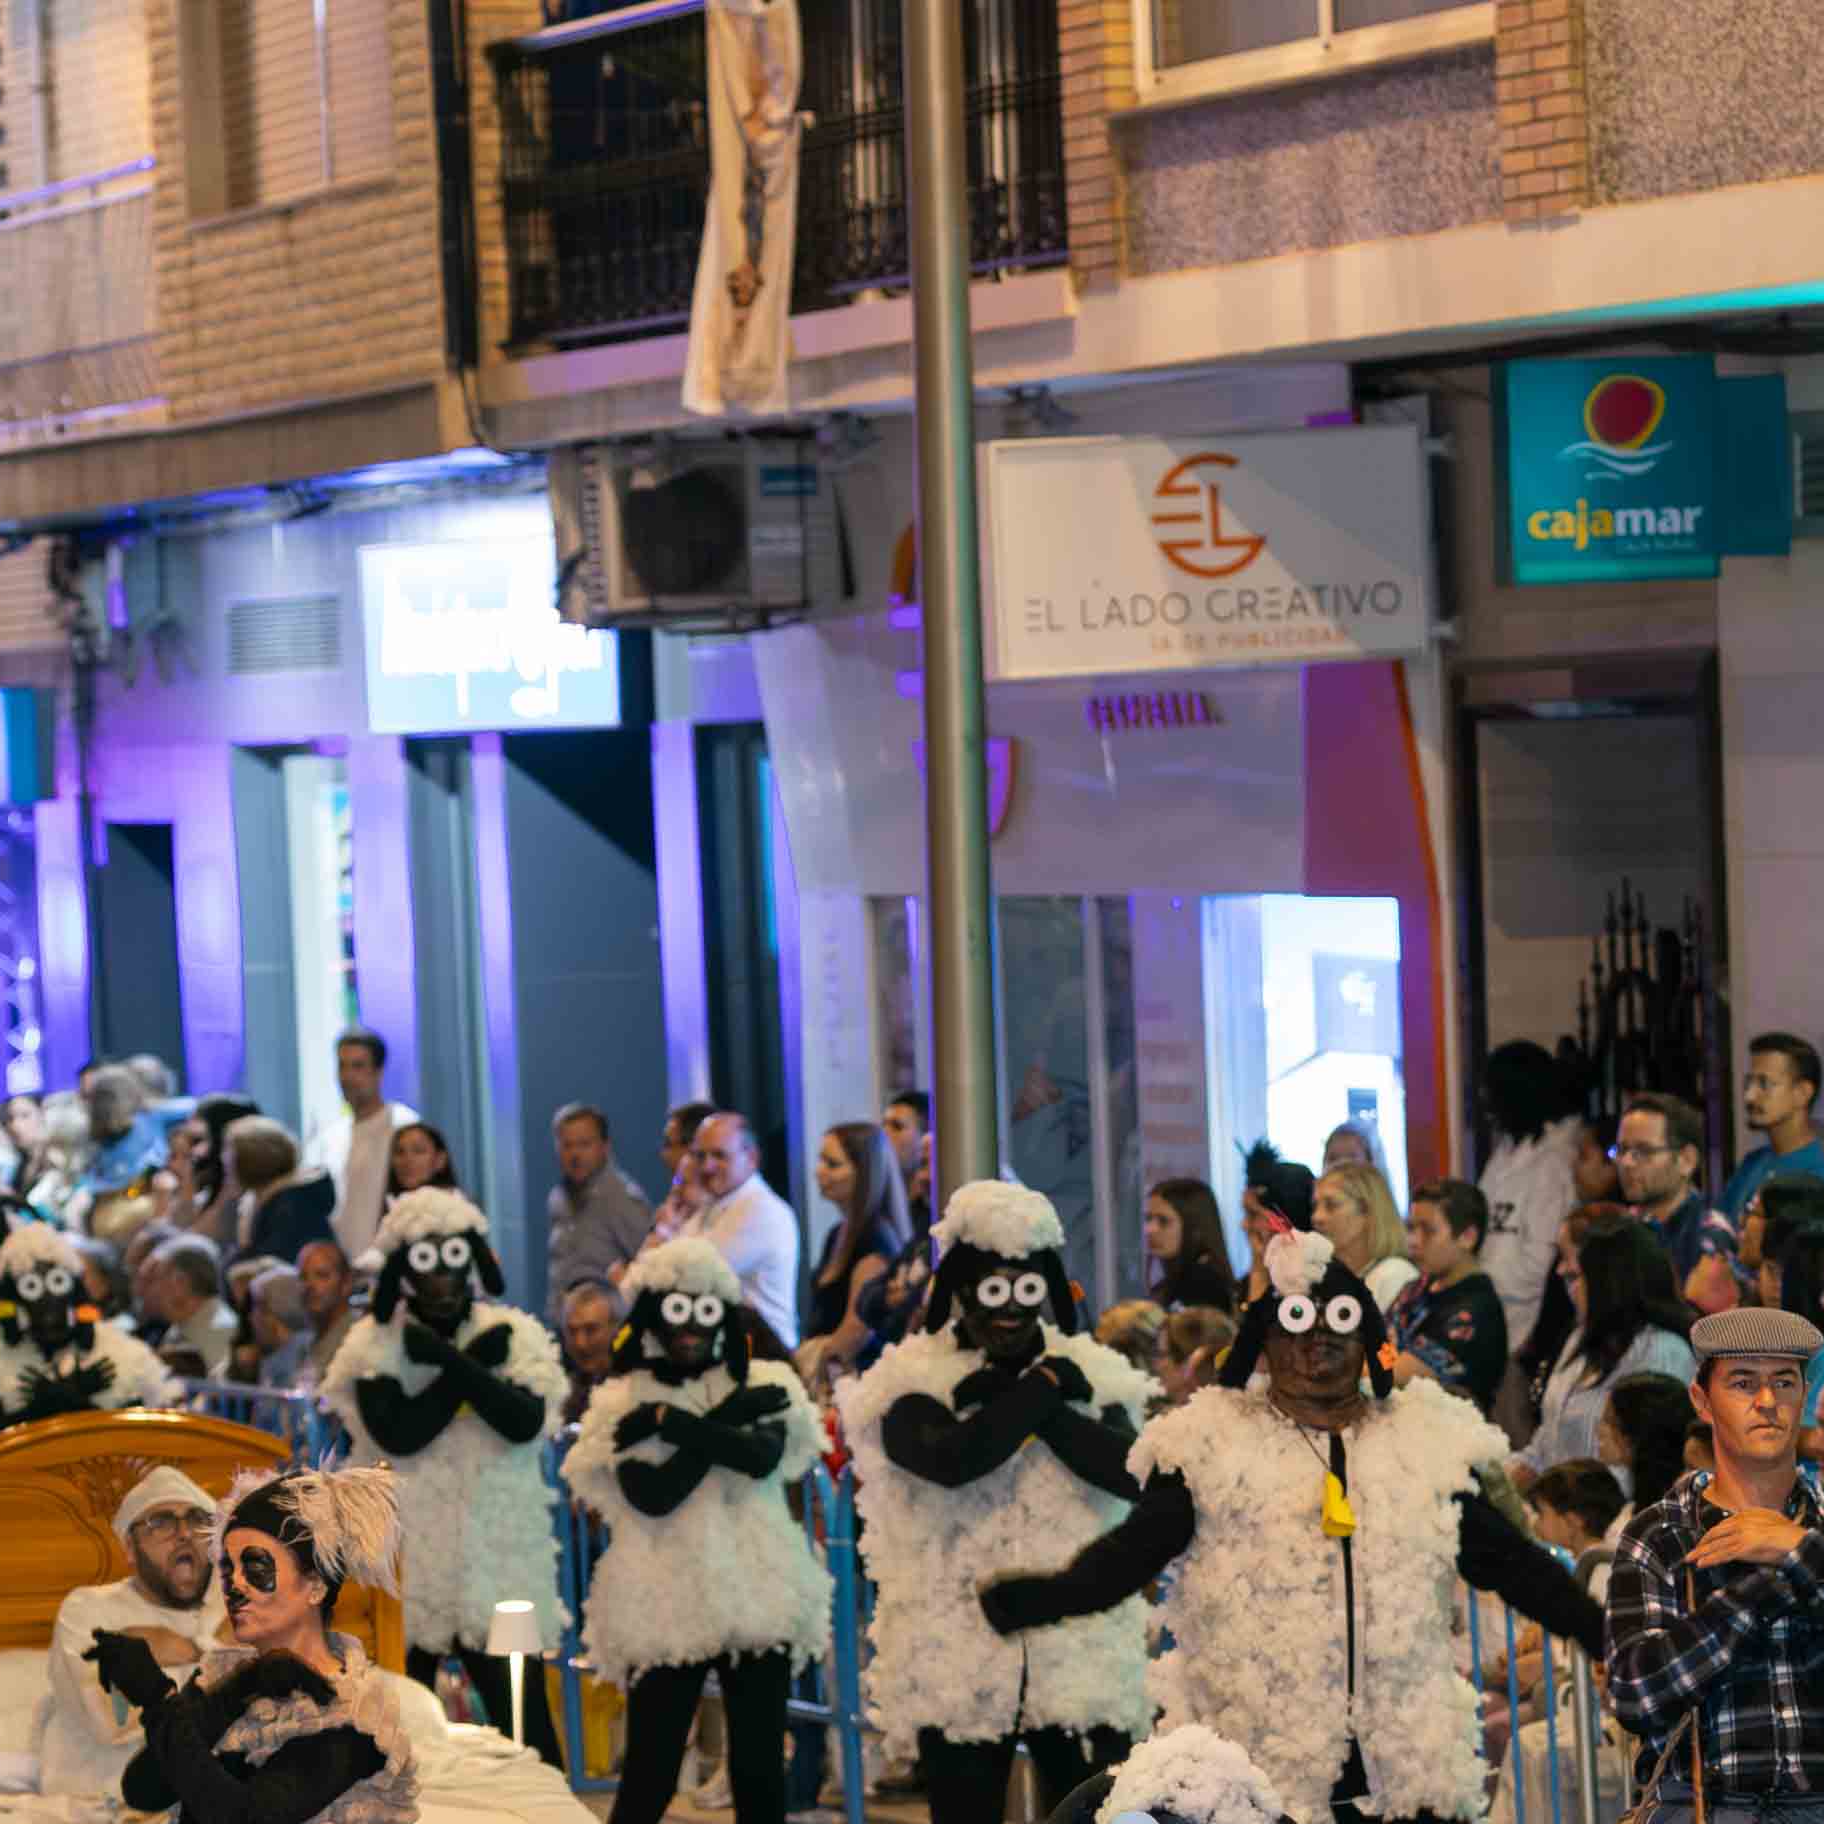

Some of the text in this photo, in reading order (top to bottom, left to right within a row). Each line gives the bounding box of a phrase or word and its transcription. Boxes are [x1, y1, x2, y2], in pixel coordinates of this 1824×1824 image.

[1528, 497, 1704, 550] cajamar
[1026, 581, 1403, 632] EL LADO CREATIVO
